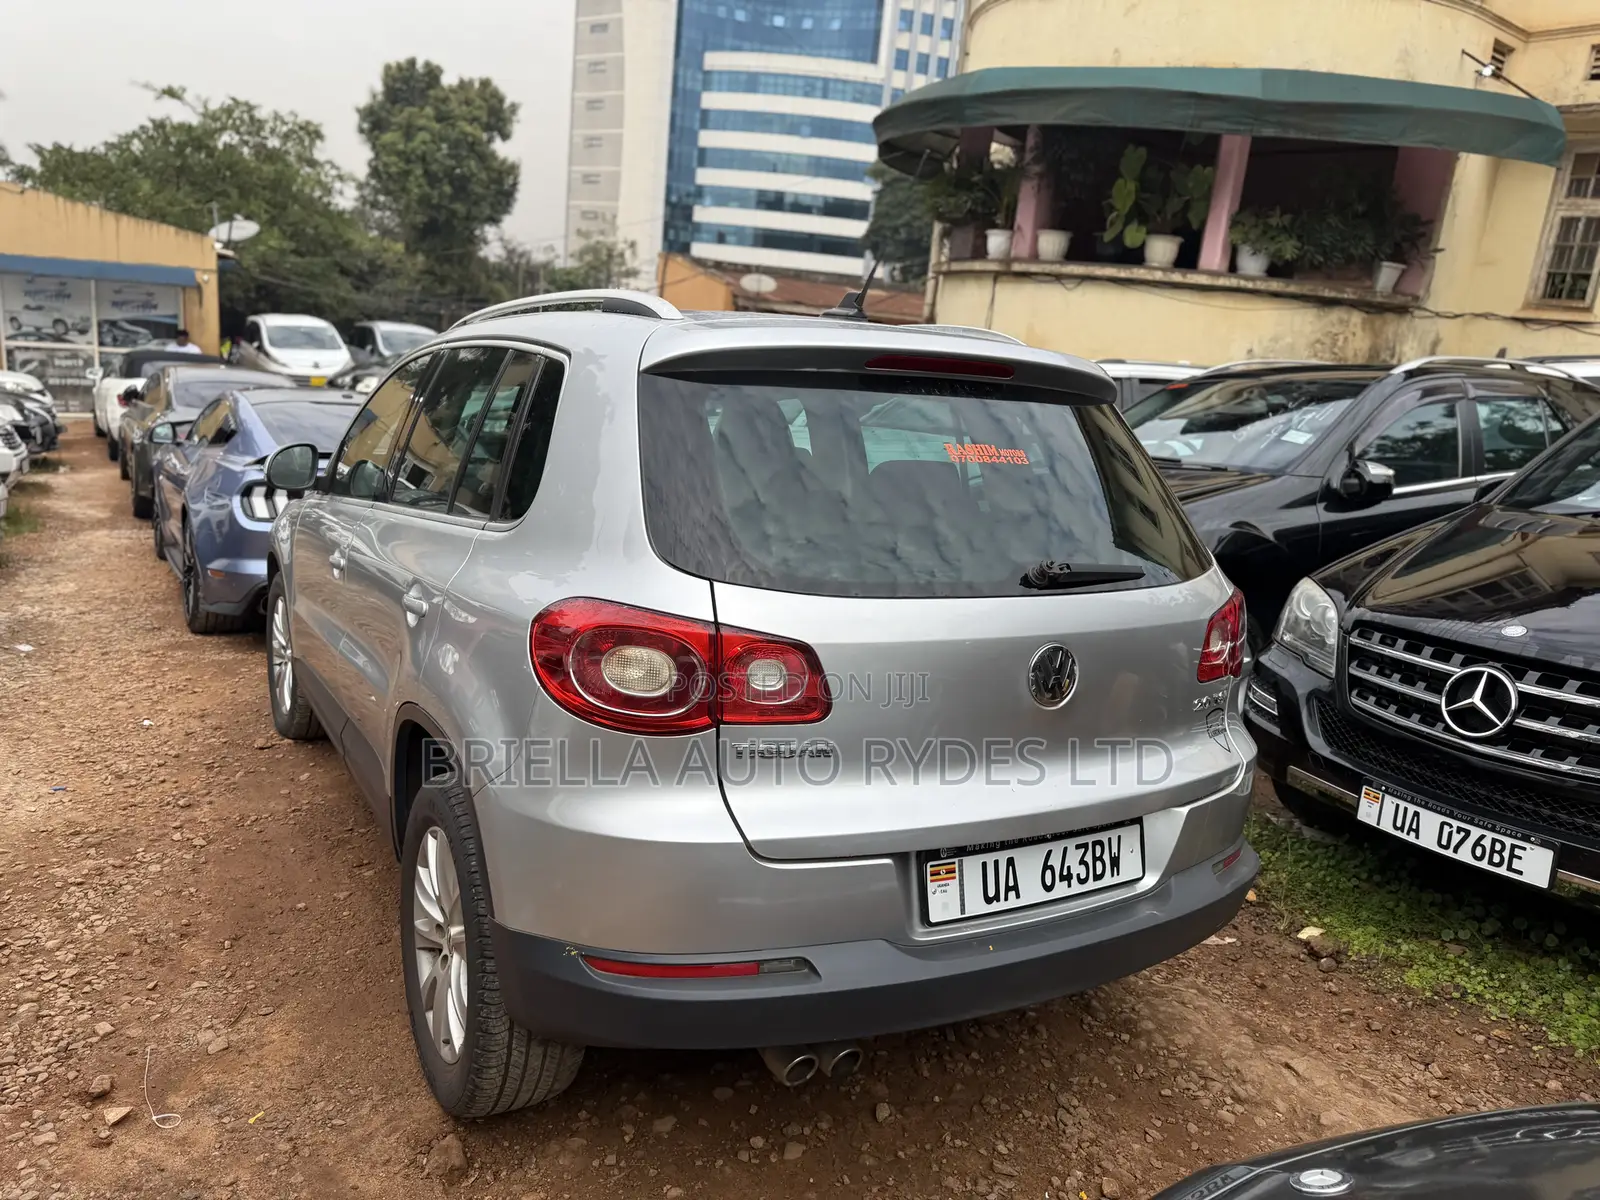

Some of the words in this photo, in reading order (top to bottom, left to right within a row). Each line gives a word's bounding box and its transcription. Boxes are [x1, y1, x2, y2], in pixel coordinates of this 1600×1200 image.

[731, 741, 834, 759] TIGUAN
[1388, 787, 1412, 802] Making
[1414, 795, 1425, 806] the
[1428, 801, 1451, 815] Roads
[1453, 809, 1471, 822] Your
[1474, 817, 1493, 829] Safe
[1496, 823, 1522, 838] Space
[1392, 802, 1421, 840] UA
[1436, 820, 1527, 876] 076BE
[981, 856, 1021, 905] UA
[1040, 834, 1122, 893] 643BW
